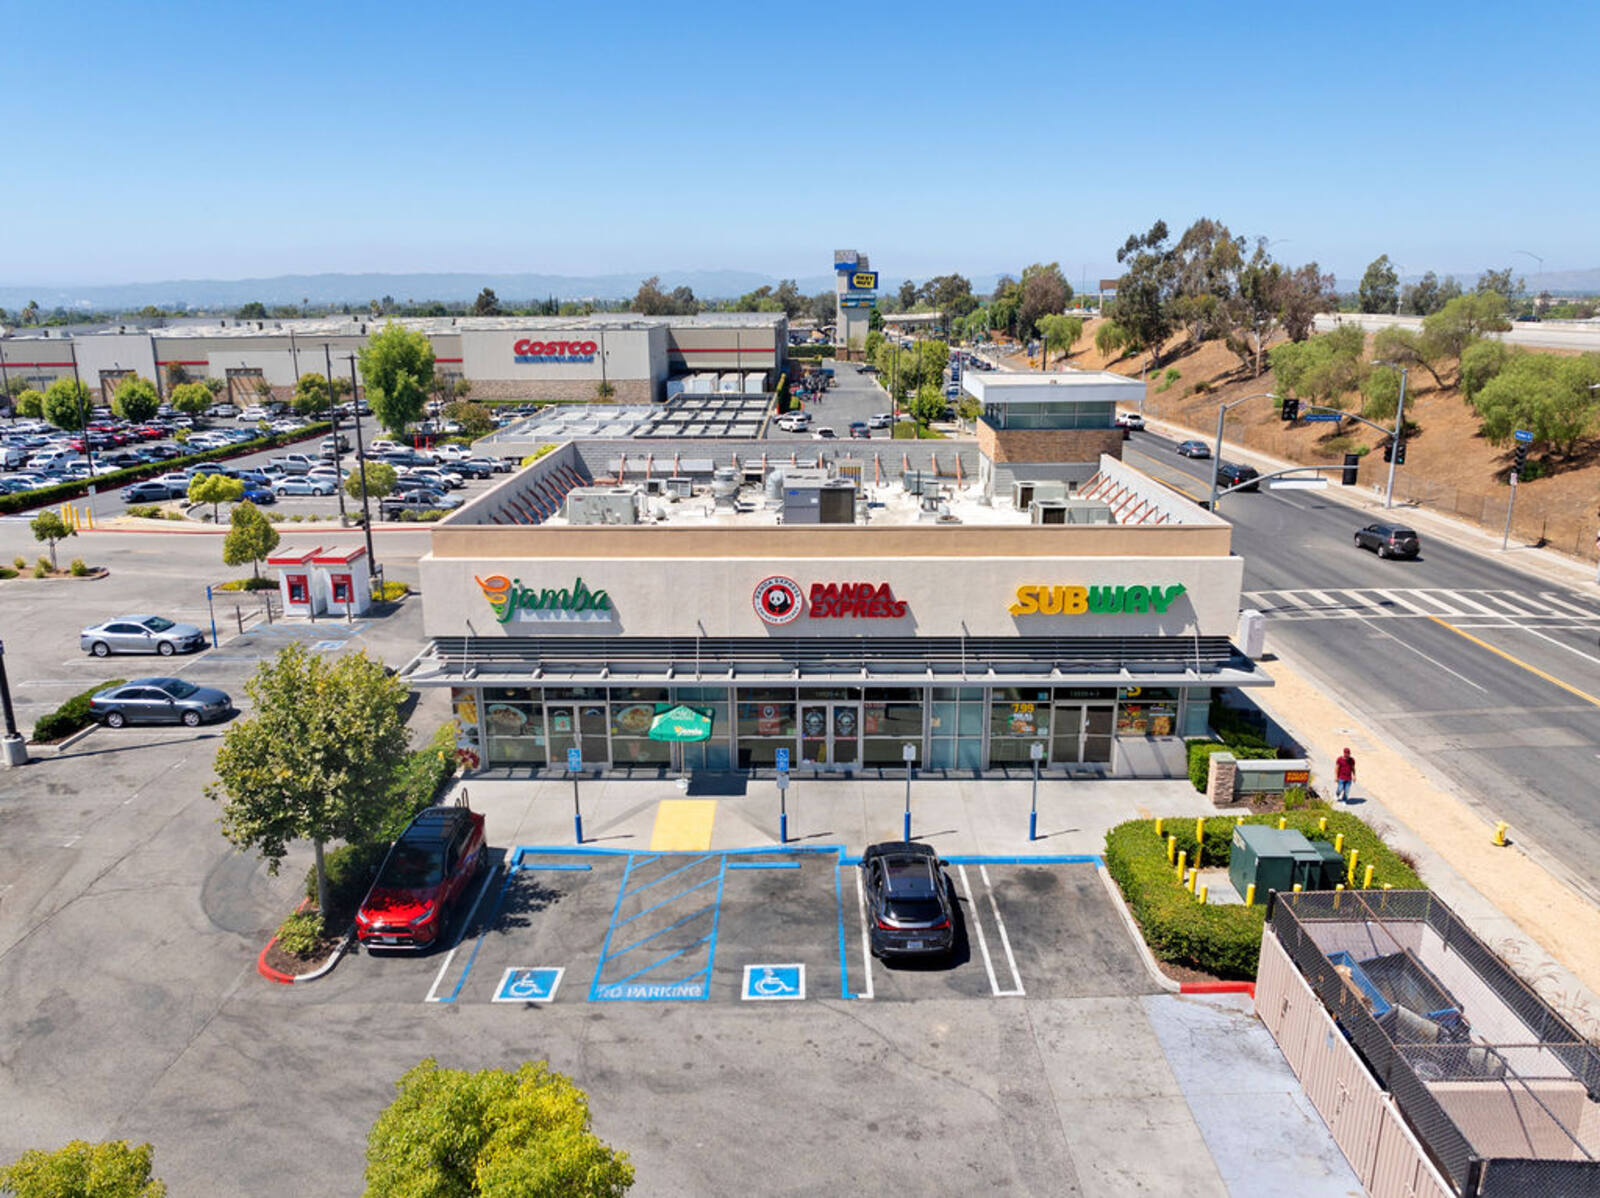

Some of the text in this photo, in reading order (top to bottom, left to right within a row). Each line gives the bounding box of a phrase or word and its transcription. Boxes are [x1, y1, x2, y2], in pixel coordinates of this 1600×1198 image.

[496, 577, 612, 624] jamba
[809, 582, 891, 601] PANDA
[1008, 583, 1187, 616] SUBWAY
[809, 600, 908, 618] EXPRESS
[626, 984, 703, 998] PARKING
